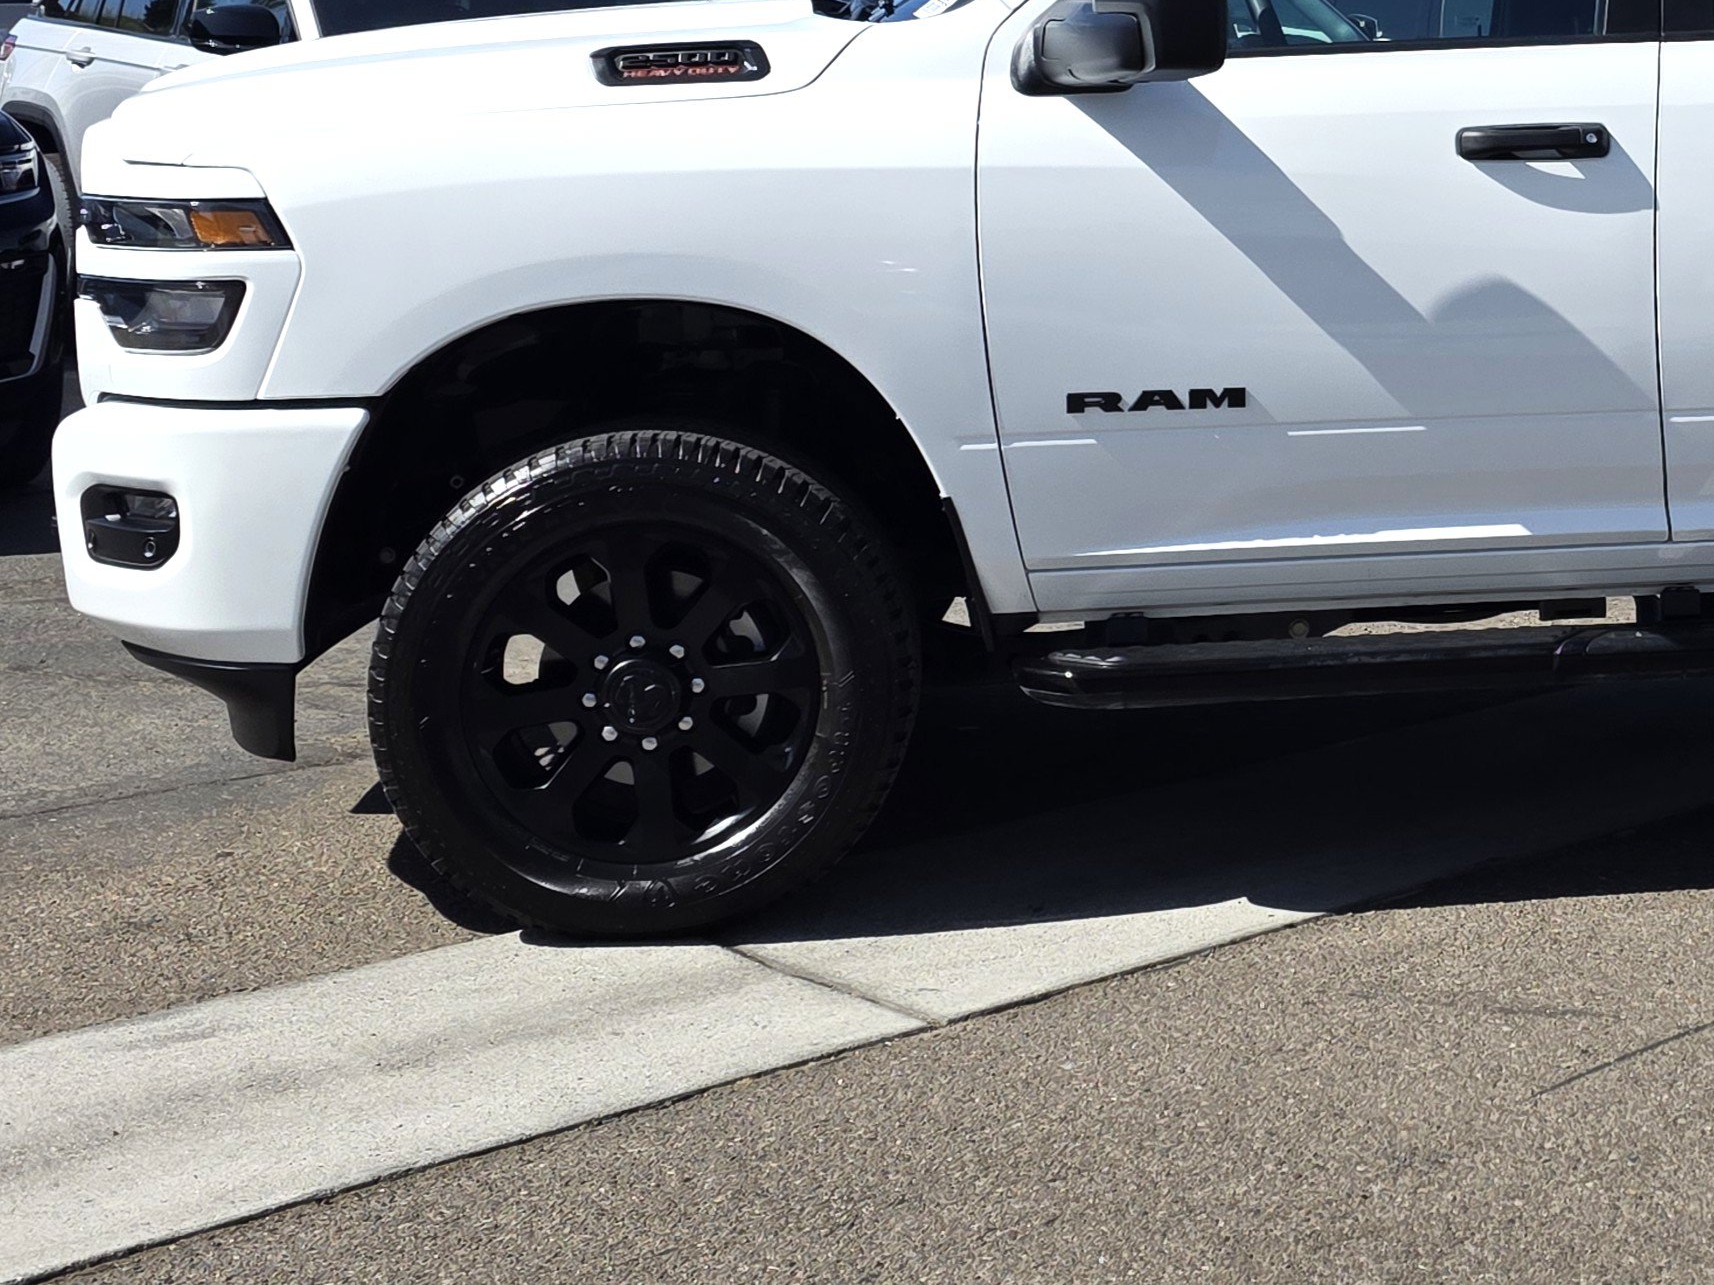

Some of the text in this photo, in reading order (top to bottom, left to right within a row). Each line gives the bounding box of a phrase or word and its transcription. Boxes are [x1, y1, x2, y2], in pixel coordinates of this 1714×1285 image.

[614, 49, 743, 72] 2500
[623, 63, 740, 78] HEAVY DUTY
[1066, 387, 1247, 414] RAM
